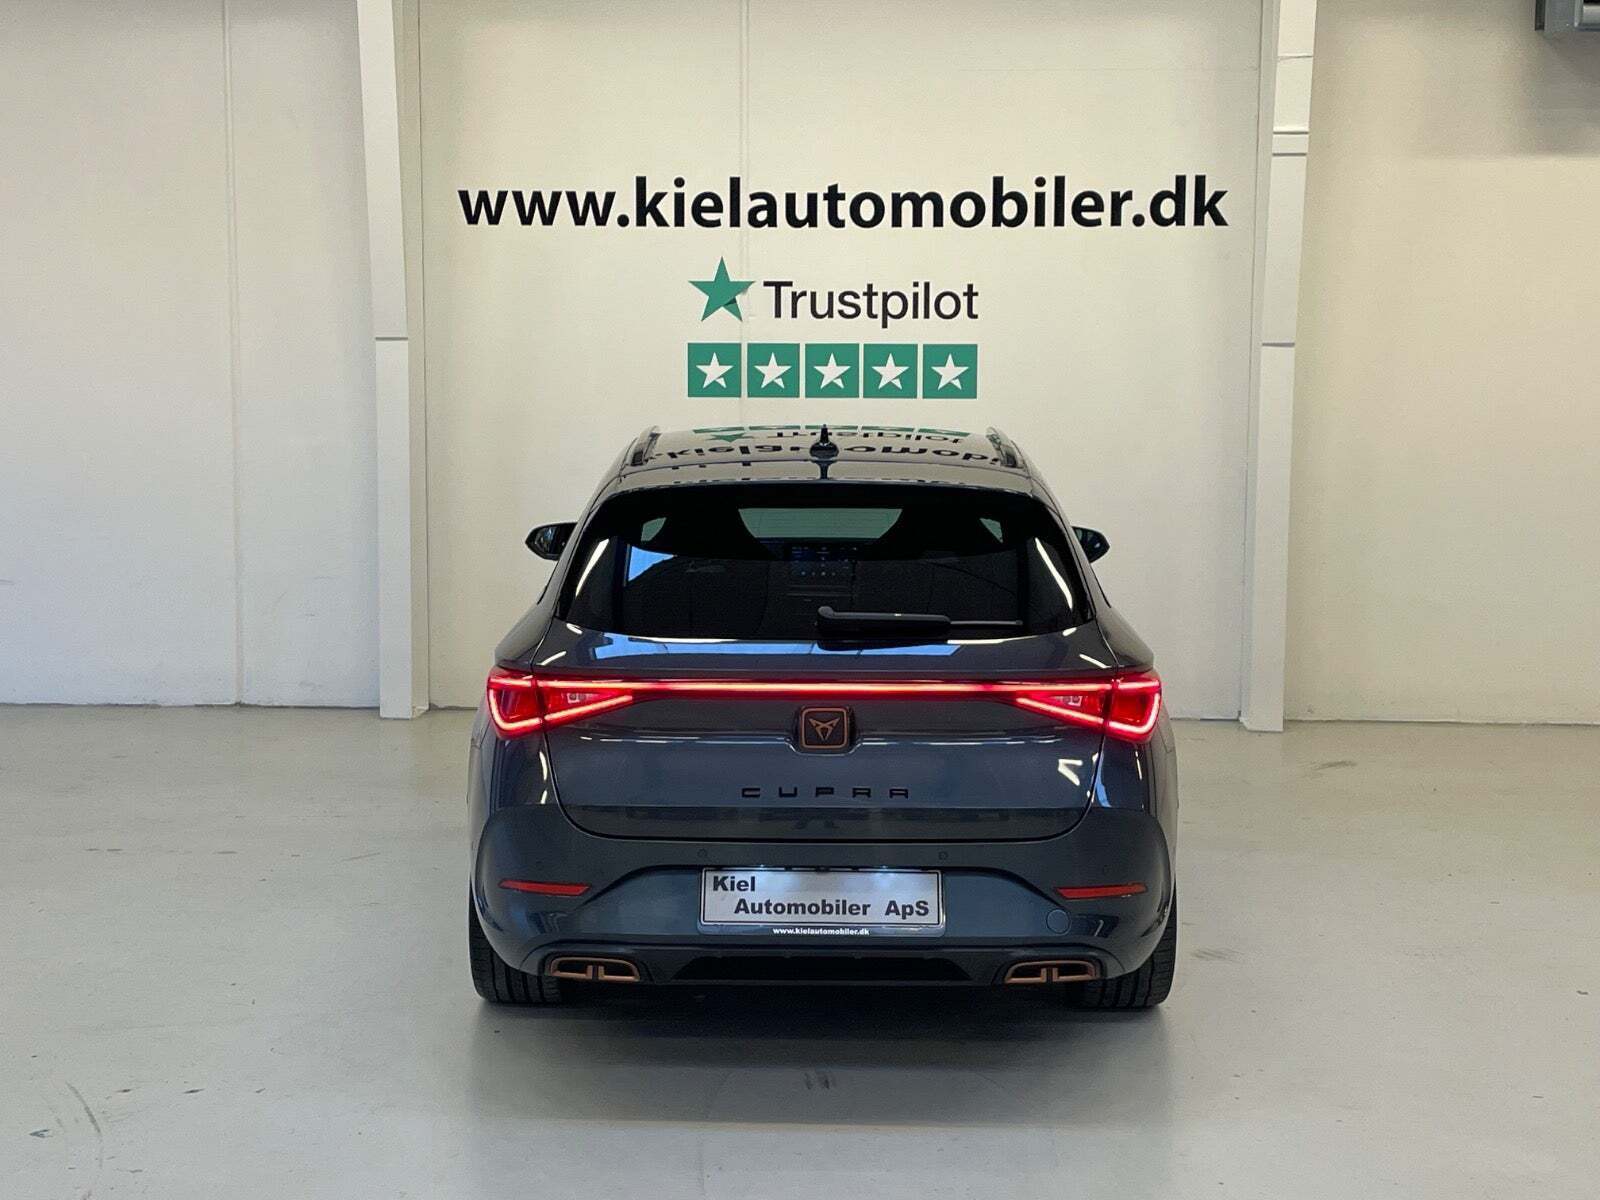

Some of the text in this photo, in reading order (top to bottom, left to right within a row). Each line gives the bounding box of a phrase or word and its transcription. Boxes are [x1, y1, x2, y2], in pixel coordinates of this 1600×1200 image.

[458, 175, 1228, 229] www.kielautomobiler.dk
[764, 280, 979, 329] Trustpilot
[741, 787, 910, 798] CUPRA
[712, 876, 756, 892] Kiel
[734, 899, 930, 920] Automobiler ApS
[772, 928, 870, 936] www.kielautomobiler.dk
